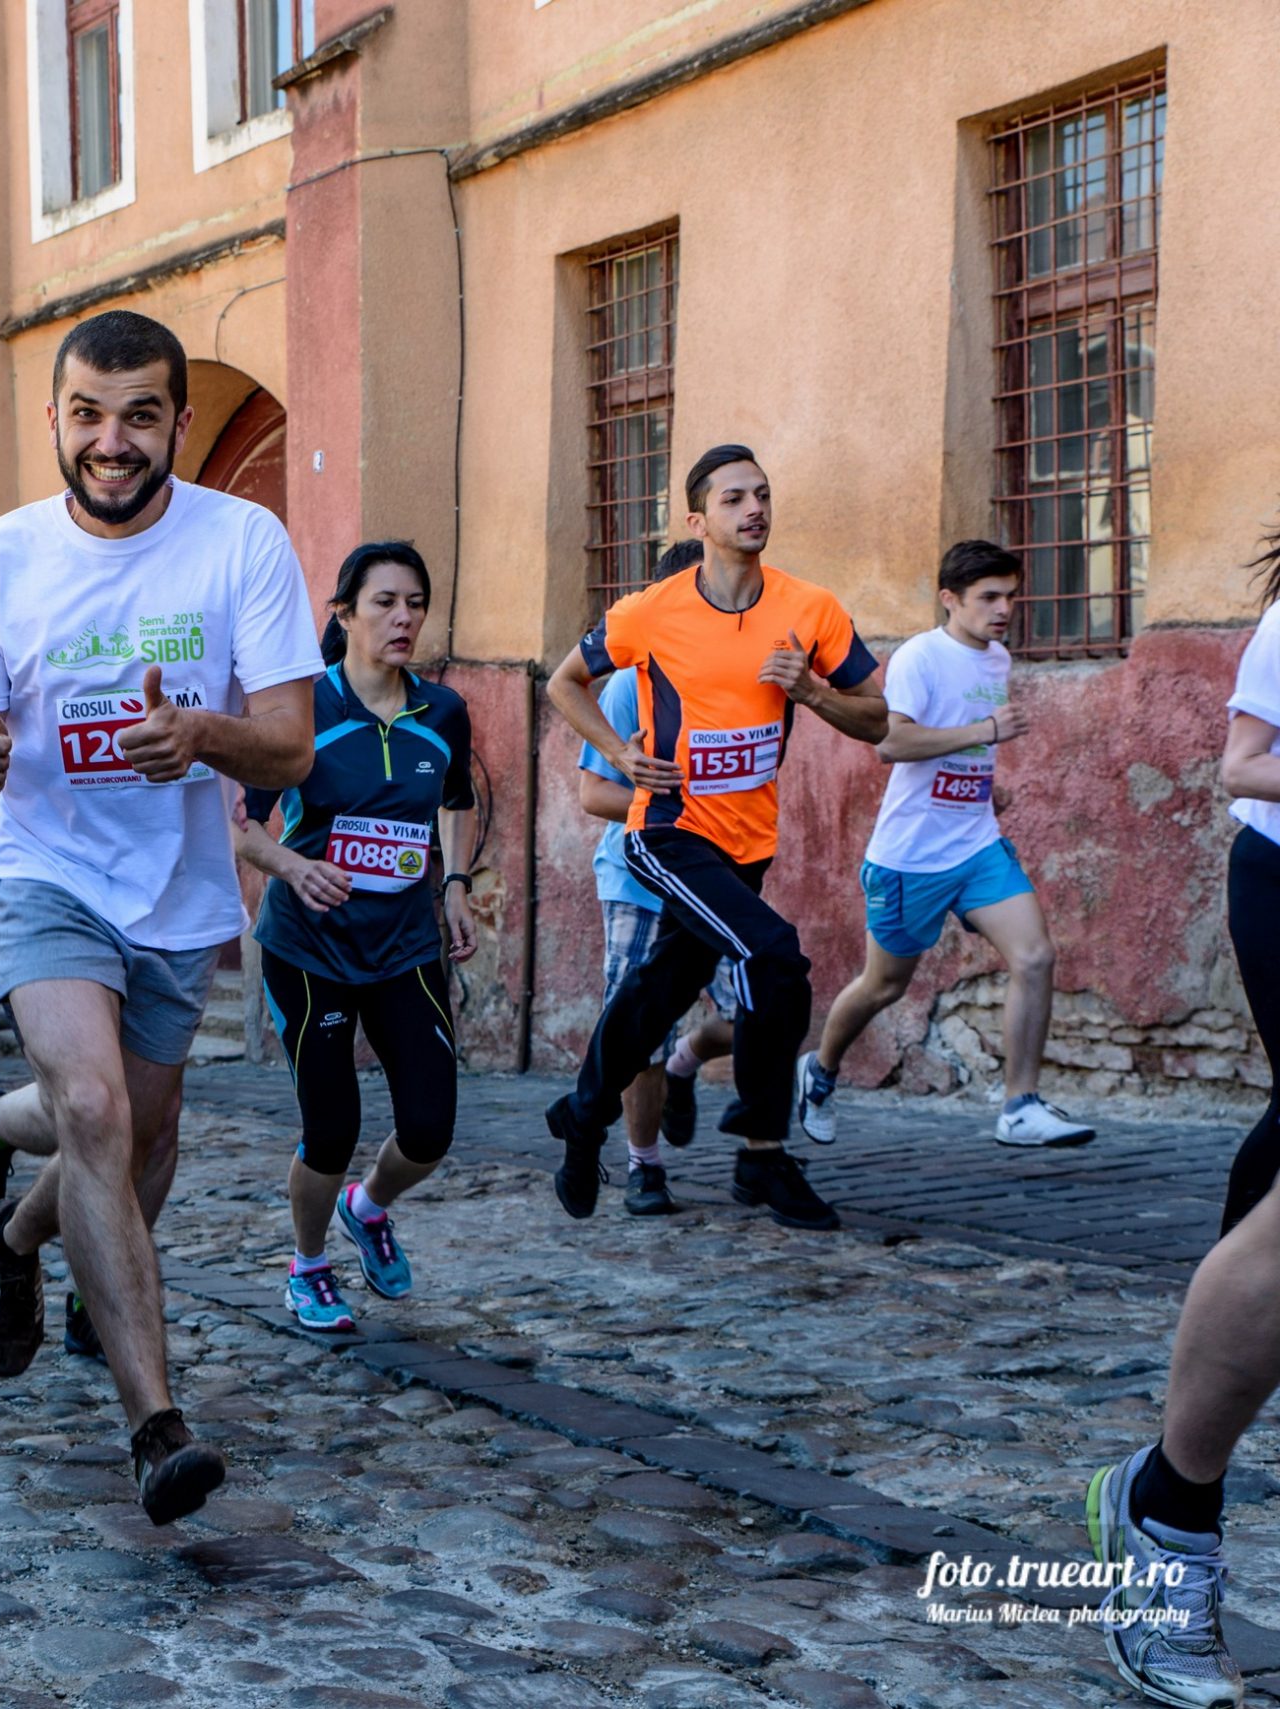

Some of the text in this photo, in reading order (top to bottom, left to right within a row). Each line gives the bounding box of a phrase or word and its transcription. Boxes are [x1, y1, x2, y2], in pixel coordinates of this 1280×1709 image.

[138, 611, 204, 627] Semi 2015
[139, 625, 186, 637] maraton
[140, 636, 204, 663] SIBIU
[62, 700, 117, 719] CROSUL
[692, 725, 779, 744] CROSUL VISMA
[691, 749, 752, 775] 1551
[70, 777, 97, 786] MIRCEA
[936, 776, 982, 798] 1495
[335, 819, 427, 841] CROSUL VISMA
[330, 839, 397, 870] 1088
